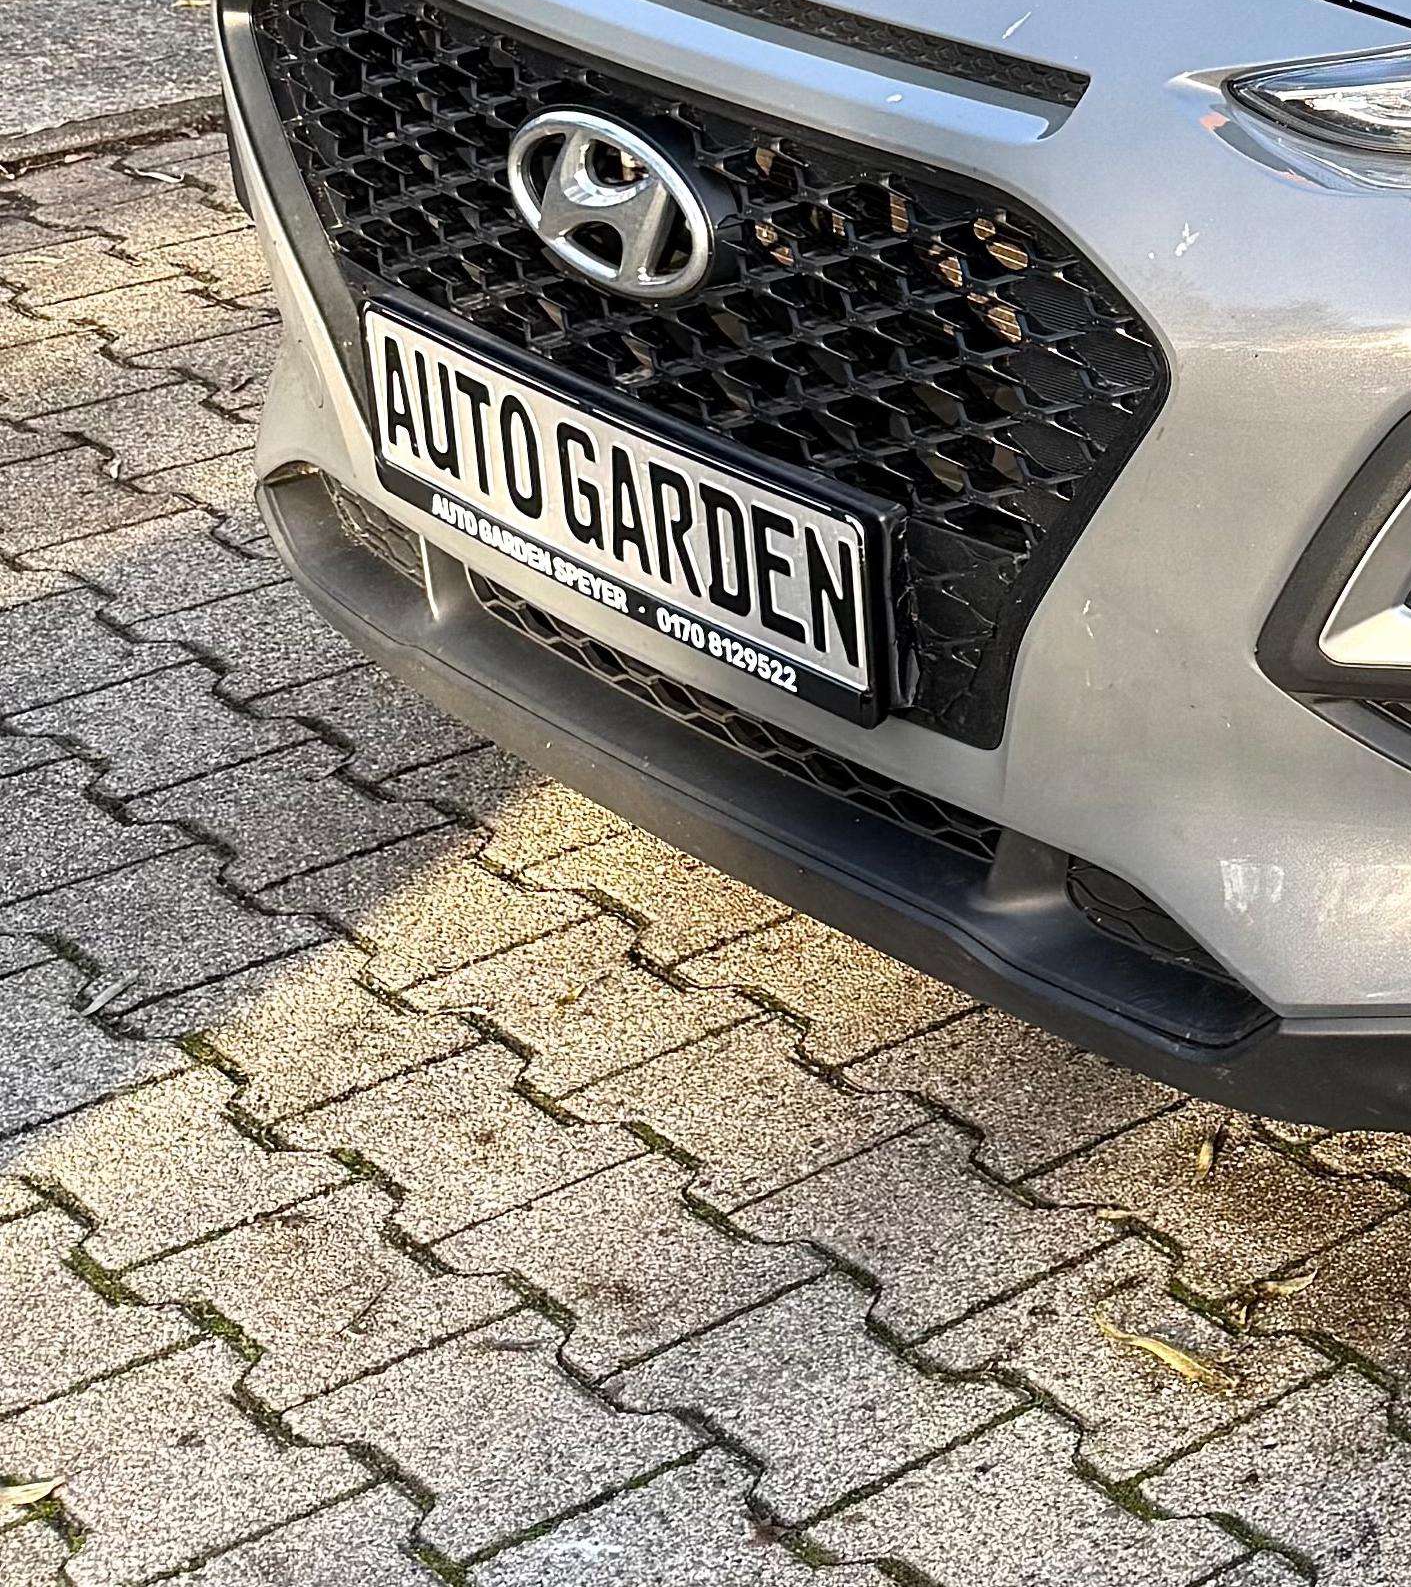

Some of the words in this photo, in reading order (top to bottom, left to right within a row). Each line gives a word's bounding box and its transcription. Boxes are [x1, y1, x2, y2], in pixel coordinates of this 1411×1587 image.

[384, 335, 543, 520] AUTO
[556, 421, 860, 668] GARDEN
[432, 493, 478, 536] AUTO
[478, 518, 552, 576] GARDEN
[552, 556, 628, 613] SPEYER
[656, 607, 705, 649] 0170
[707, 631, 798, 693] 8129522
